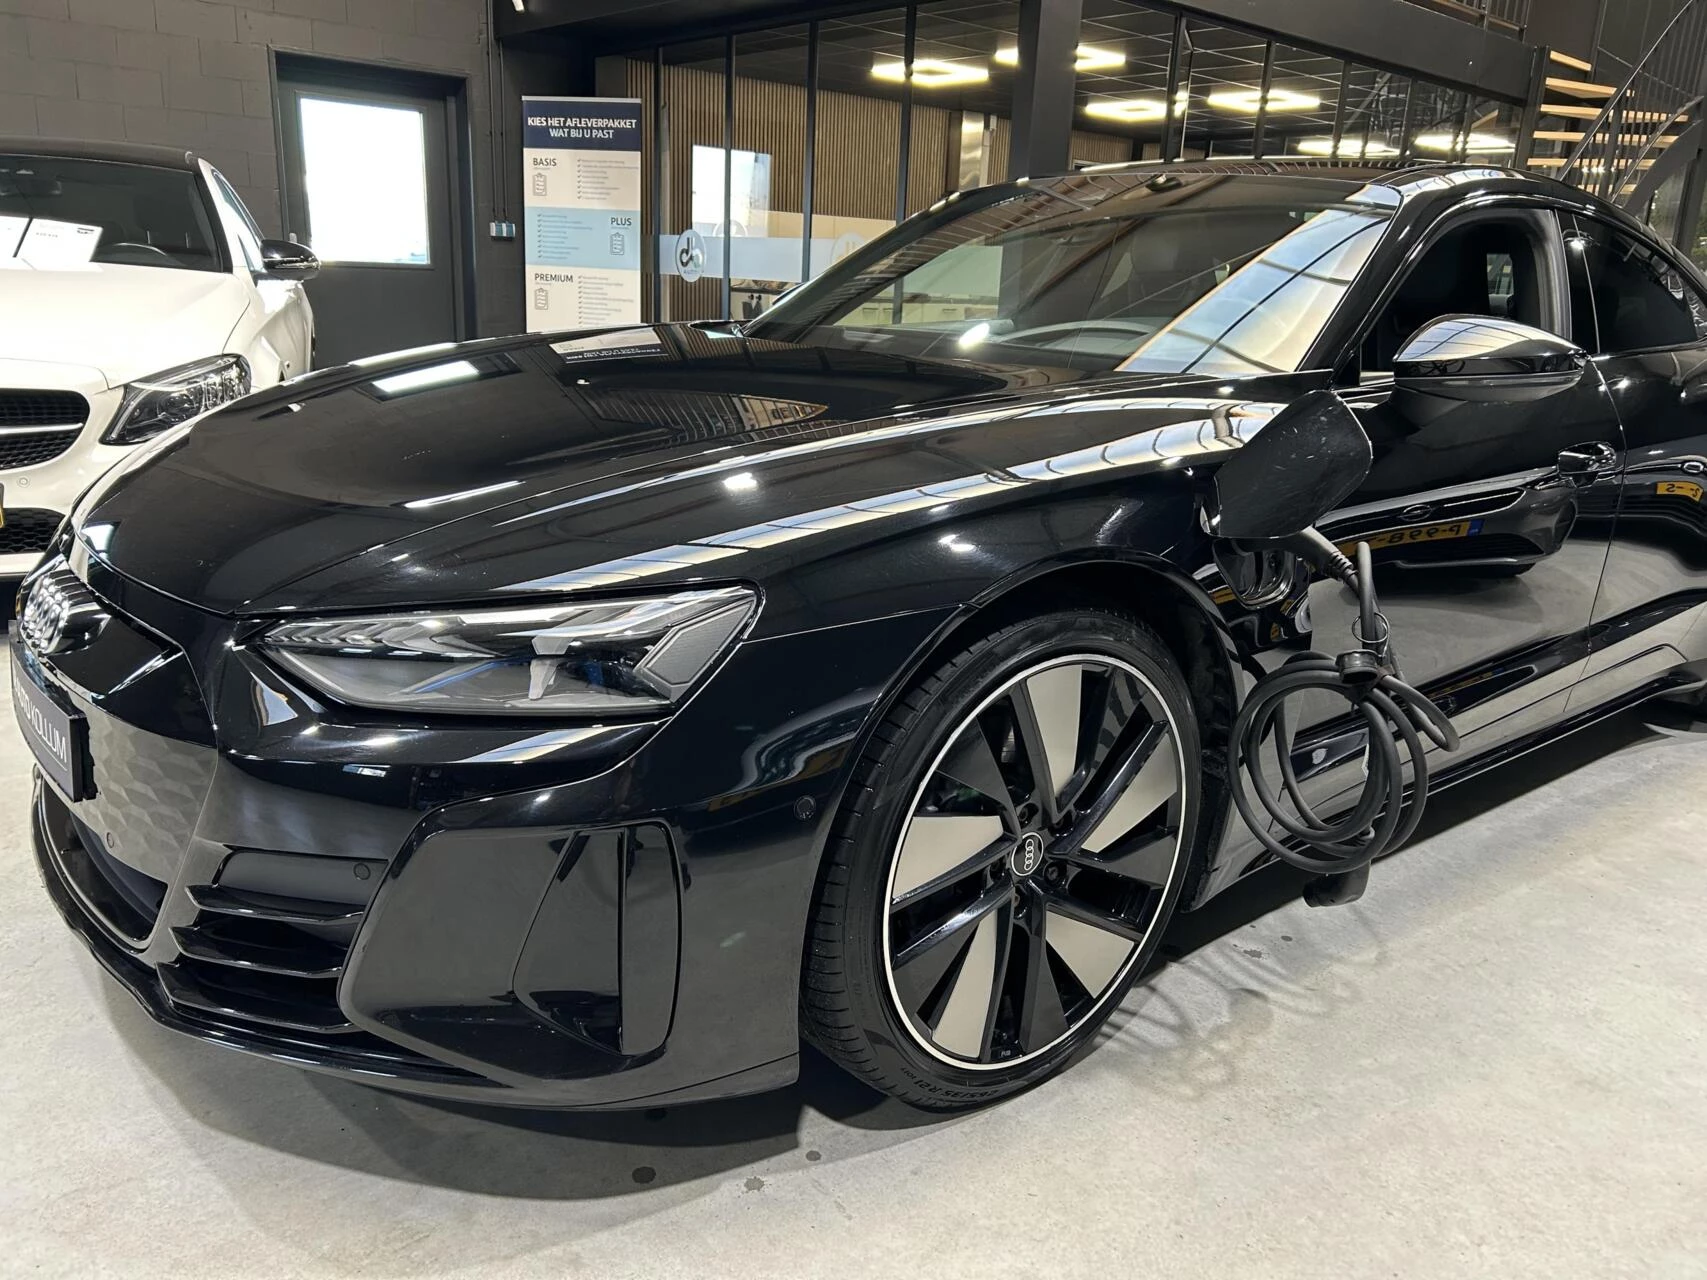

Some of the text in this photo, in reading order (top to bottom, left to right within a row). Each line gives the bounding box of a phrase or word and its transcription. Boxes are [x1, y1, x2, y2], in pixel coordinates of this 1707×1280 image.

[528, 117, 637, 128] KIES HET AFLEVERPAKKET
[549, 128, 614, 139] WAT BIJ U PAST
[533, 158, 557, 167] BASIS
[610, 217, 632, 226] PLUS
[534, 273, 574, 283] PREMIUM
[30, 702, 67, 763] KOLLUM
